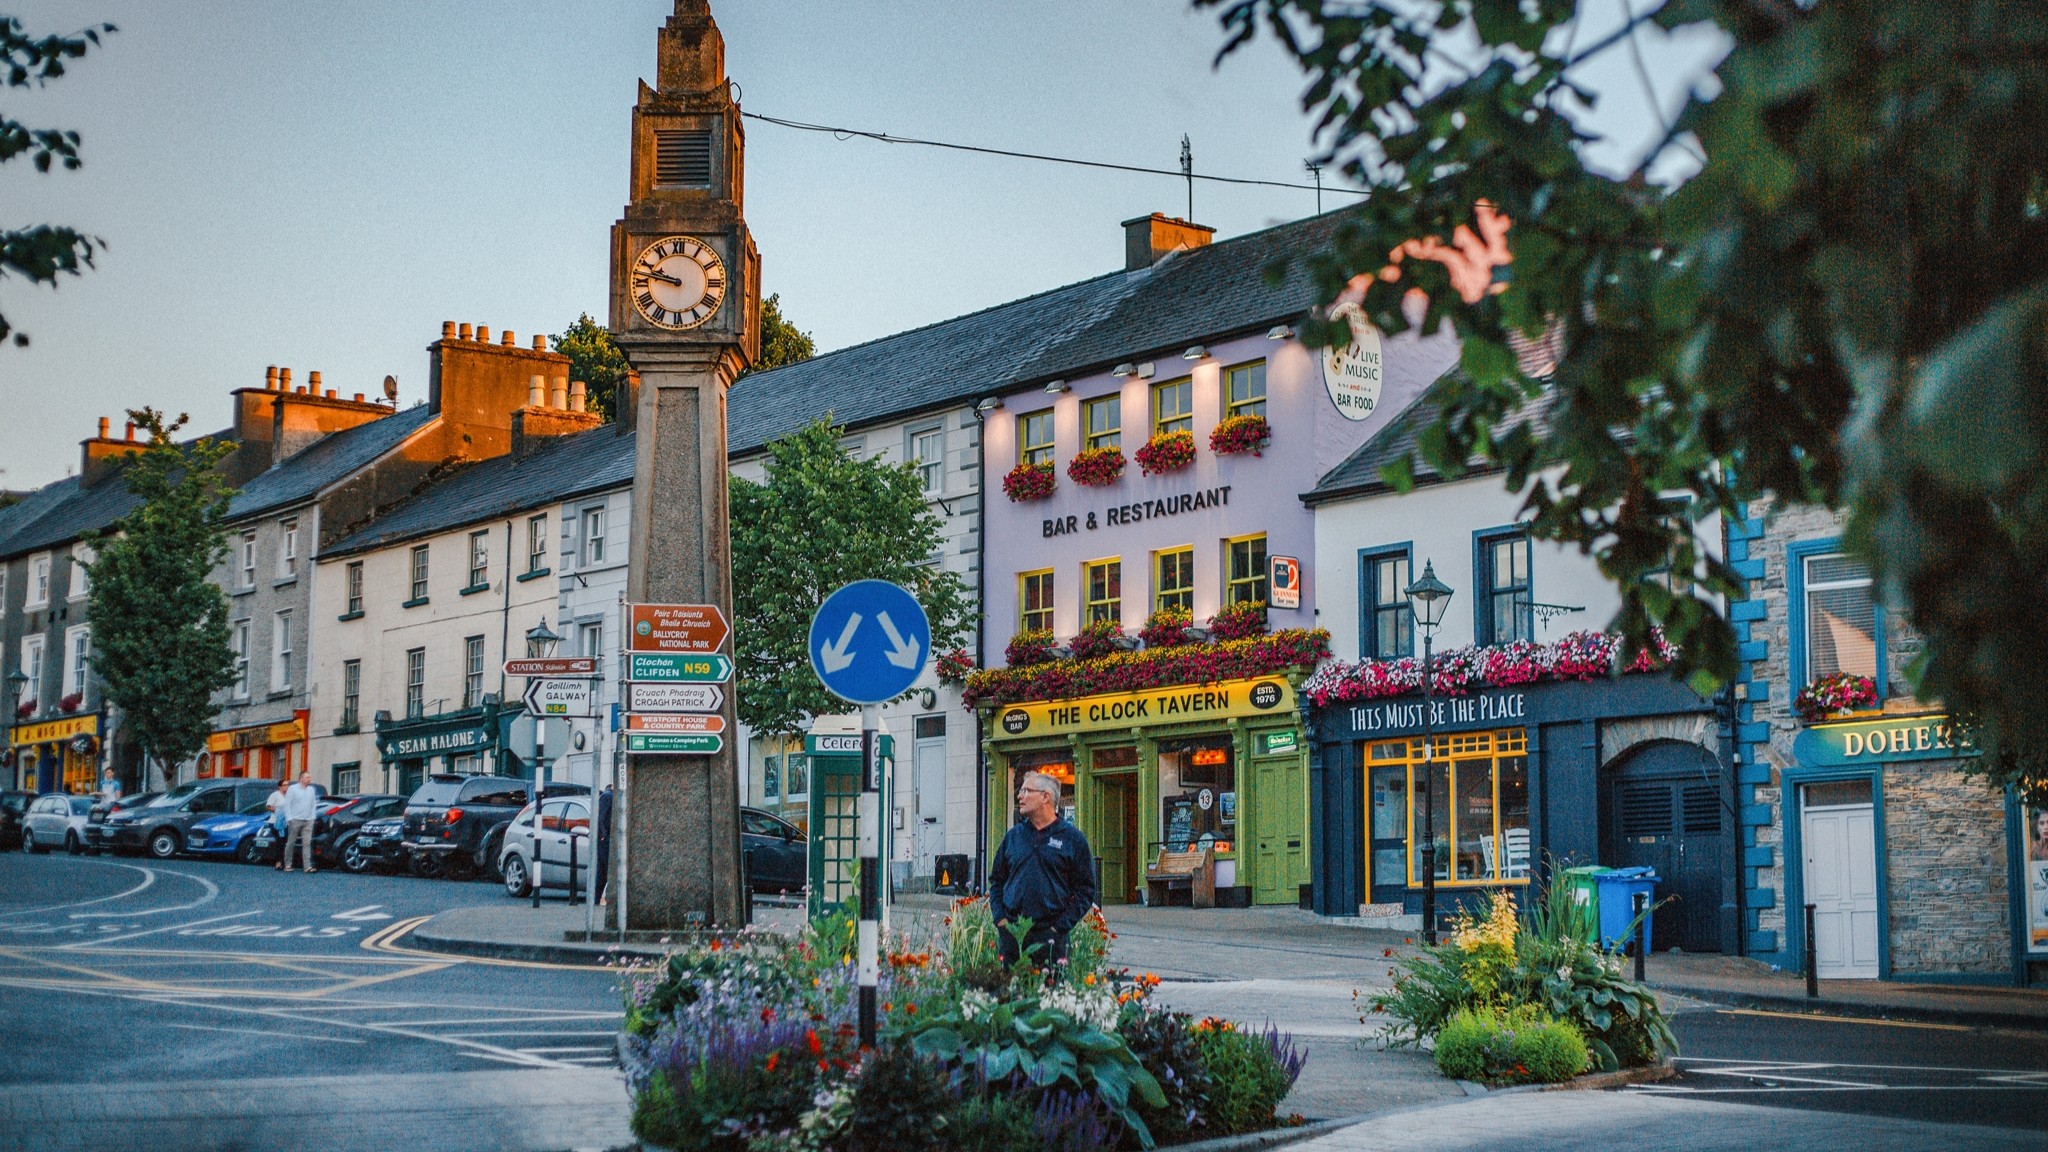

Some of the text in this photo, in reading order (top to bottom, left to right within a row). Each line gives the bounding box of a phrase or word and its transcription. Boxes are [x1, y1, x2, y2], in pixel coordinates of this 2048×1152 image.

[1361, 351, 1379, 365] LIVE
[1346, 364, 1378, 381] MUSIC
[1337, 393, 1374, 410] BAR FOOD
[1043, 485, 1231, 538] BAR & RESTAURANT
[653, 630, 689, 639] BALLYCROY
[660, 640, 709, 649] NATIONAL PARK
[511, 663, 544, 672] STATION
[684, 662, 711, 674] N59
[635, 668, 680, 677] CLIFDEN
[546, 682, 582, 690] Gaillimh
[546, 692, 587, 700] GALWAY
[635, 689, 666, 697] Cruach
[671, 699, 705, 707] PATRICK
[1256, 694, 1276, 703] 1976
[546, 704, 566, 713] N84
[1048, 691, 1230, 726] THE CLOCK TAVERN
[1010, 722, 1023, 731] BAR
[399, 730, 475, 754] SEAN MALONE
[1843, 724, 1971, 756] DOHER
